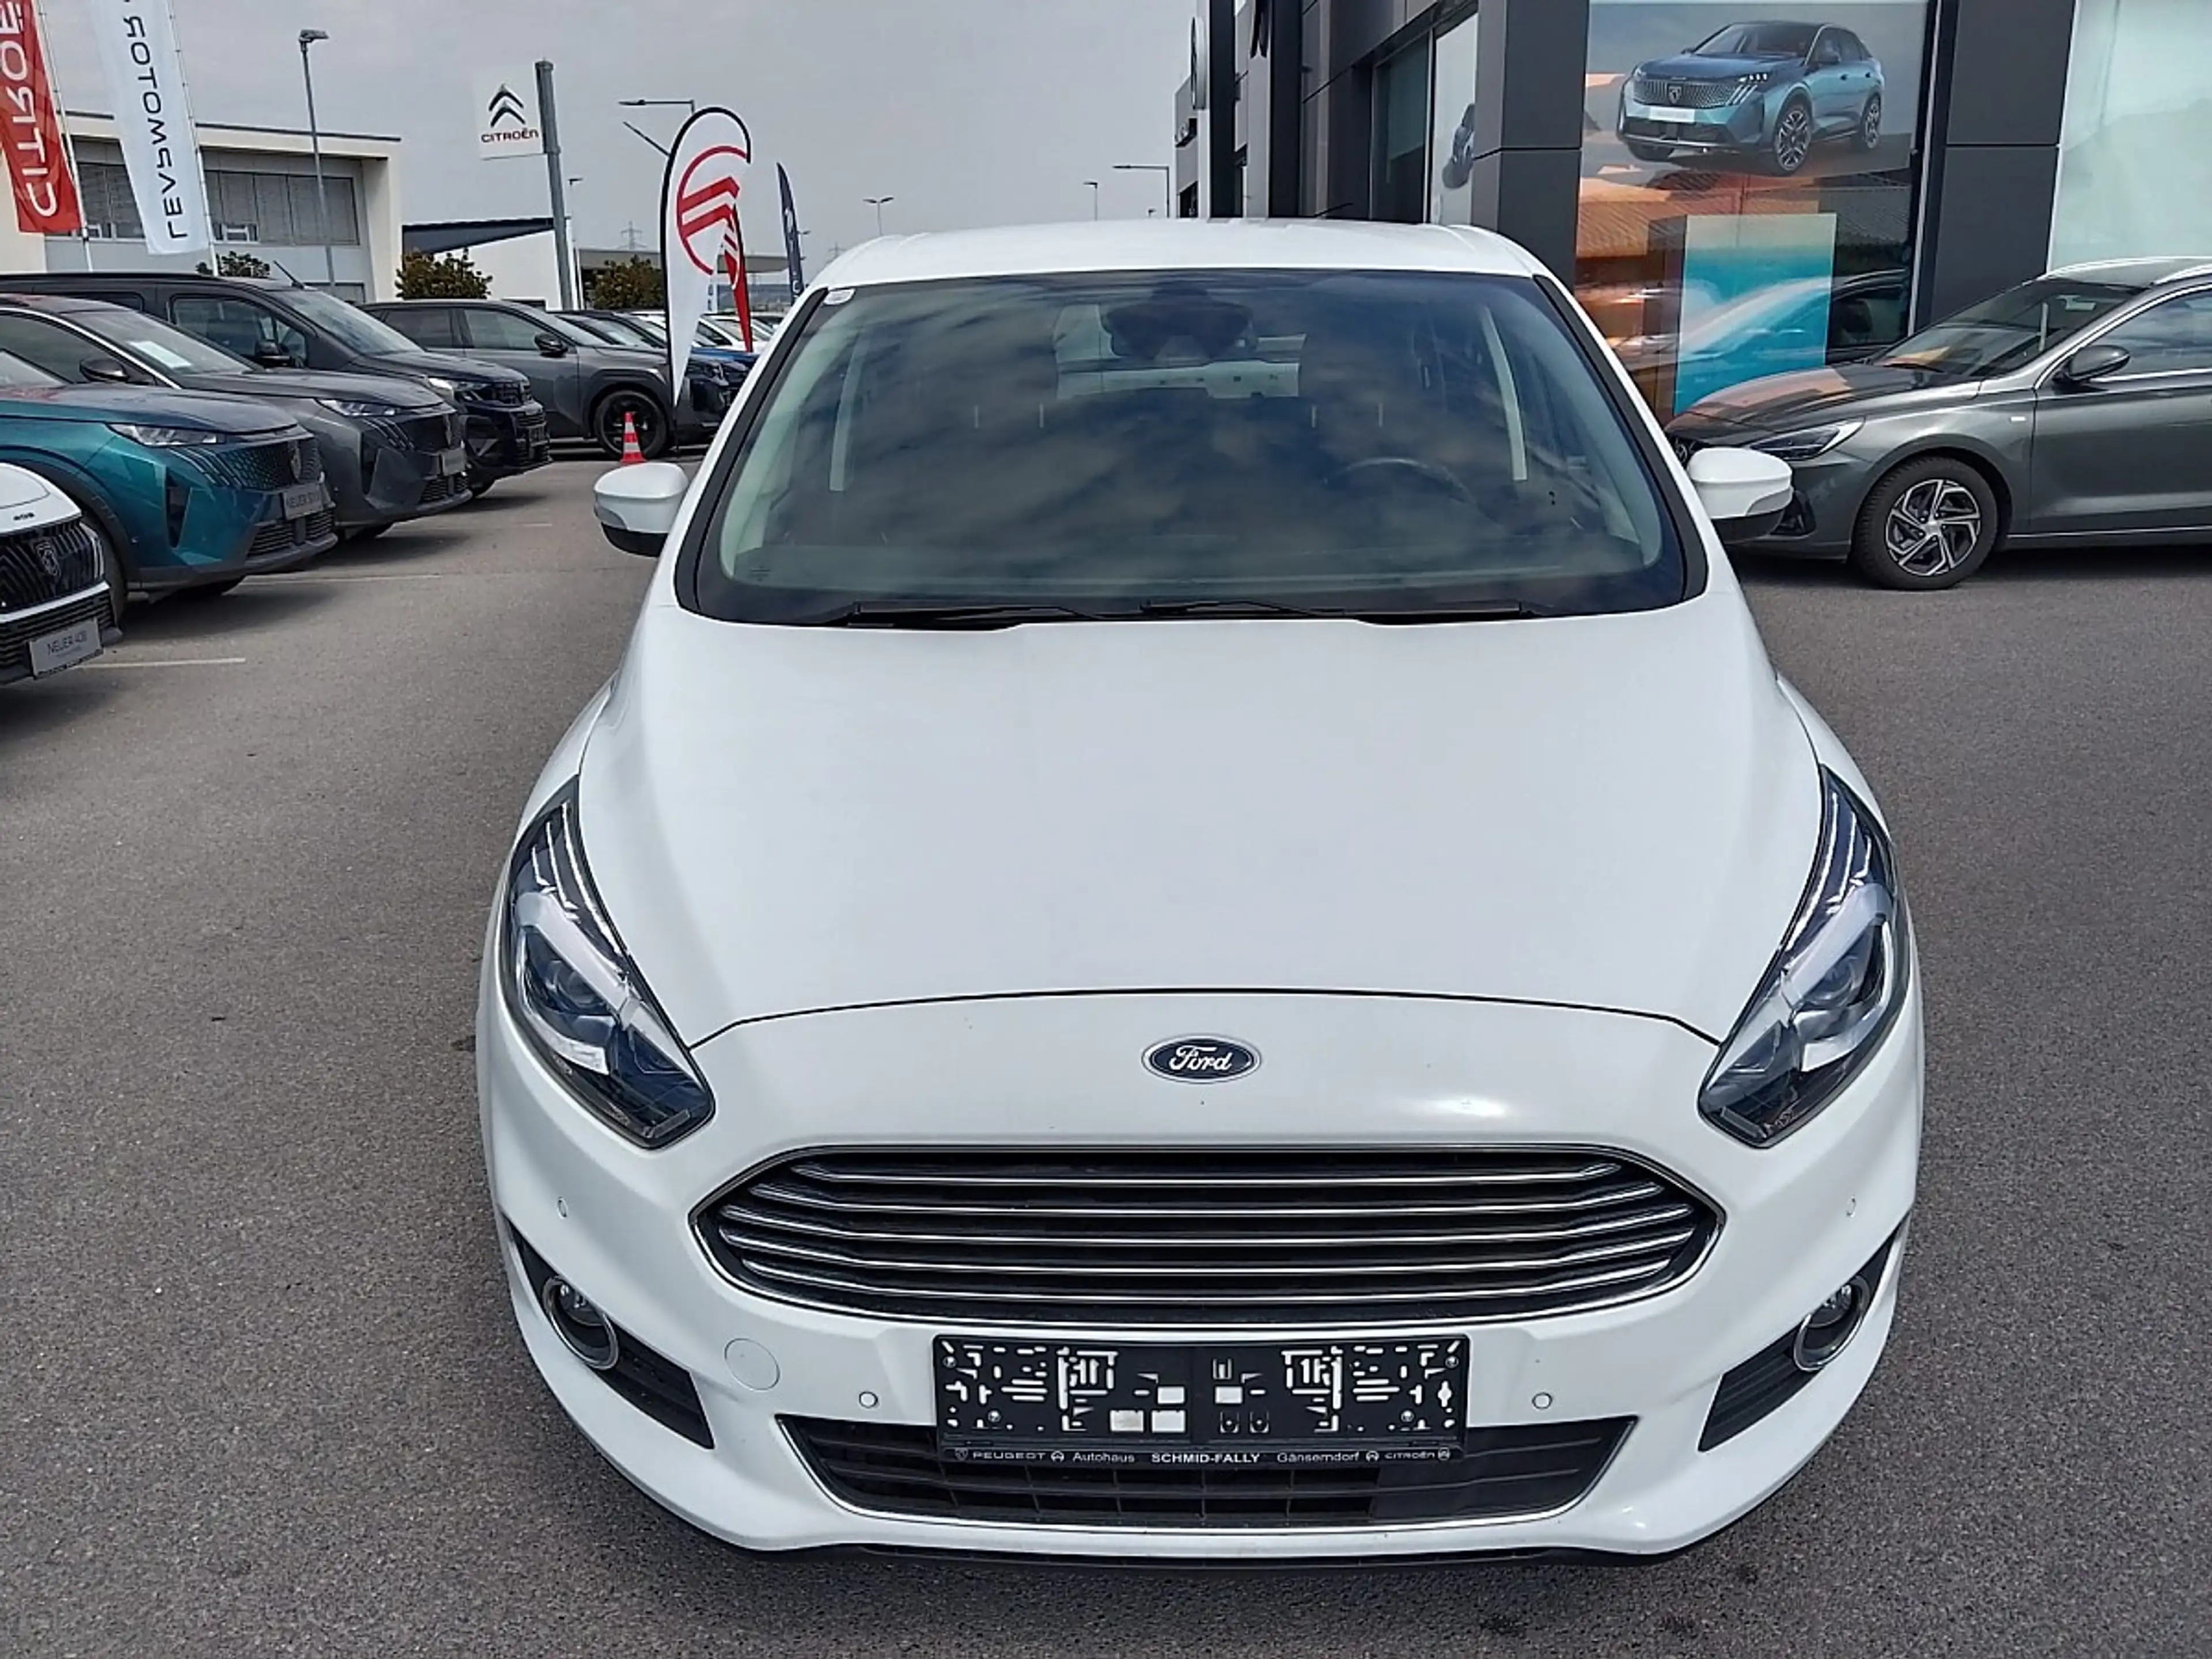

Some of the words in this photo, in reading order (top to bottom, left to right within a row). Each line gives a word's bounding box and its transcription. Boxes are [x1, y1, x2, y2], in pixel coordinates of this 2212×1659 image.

[1168, 1044, 1234, 1071] Ford
[972, 1451, 1046, 1460] PEUGEOT
[1072, 1451, 1135, 1463] Autohaus
[1151, 1452, 1260, 1464] SCHMID-FALLY
